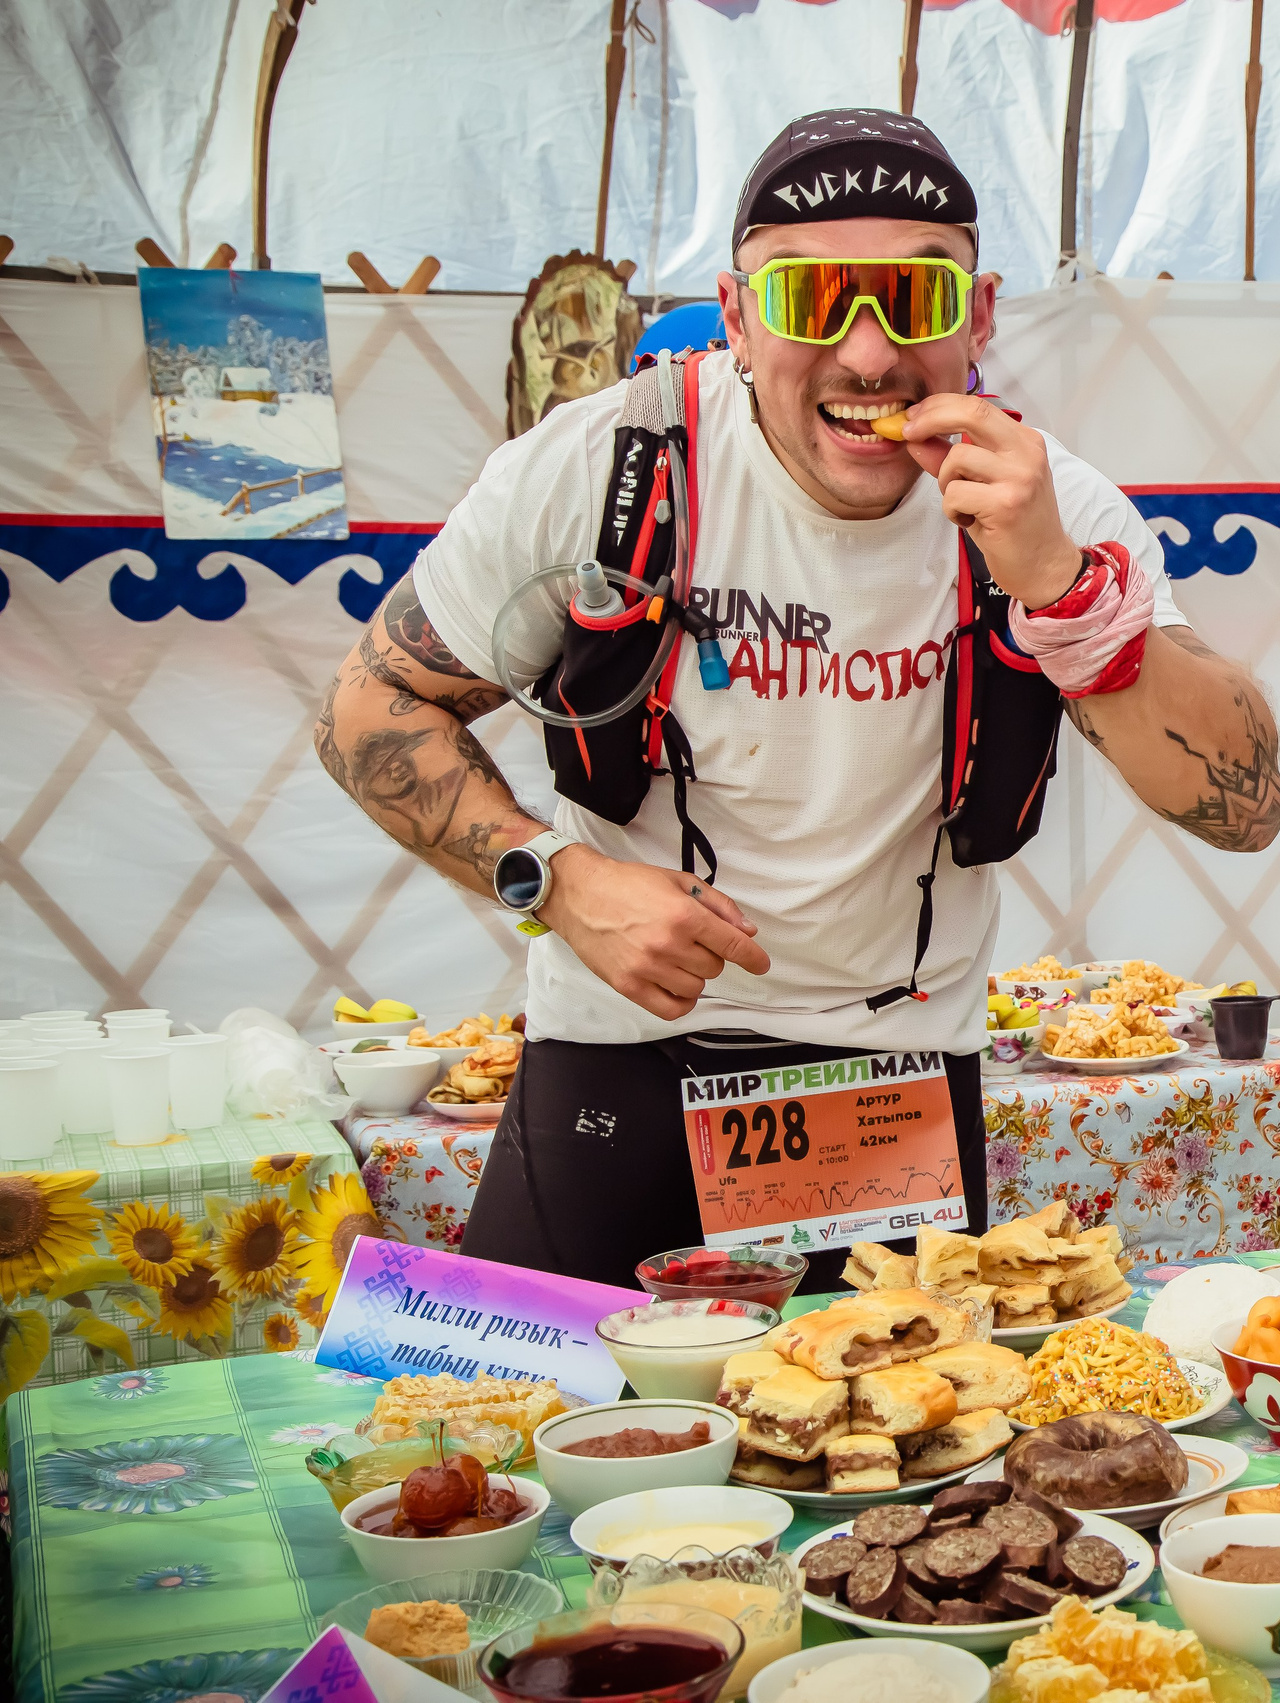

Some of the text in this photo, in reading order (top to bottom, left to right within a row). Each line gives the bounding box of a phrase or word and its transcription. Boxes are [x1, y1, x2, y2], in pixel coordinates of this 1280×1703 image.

[773, 164, 950, 212] FUCK CARS
[855, 1092, 902, 1108] Артур
[857, 1109, 923, 1128] Хатыпов
[721, 1100, 810, 1170] 228
[818, 1143, 847, 1155] СТАРТ
[825, 1155, 849, 1165] 10:00
[719, 1176, 737, 1186] Ufa
[763, 1235, 783, 1246] PRO
[394, 1286, 483, 1331] Милли
[390, 1343, 480, 1378] табын
